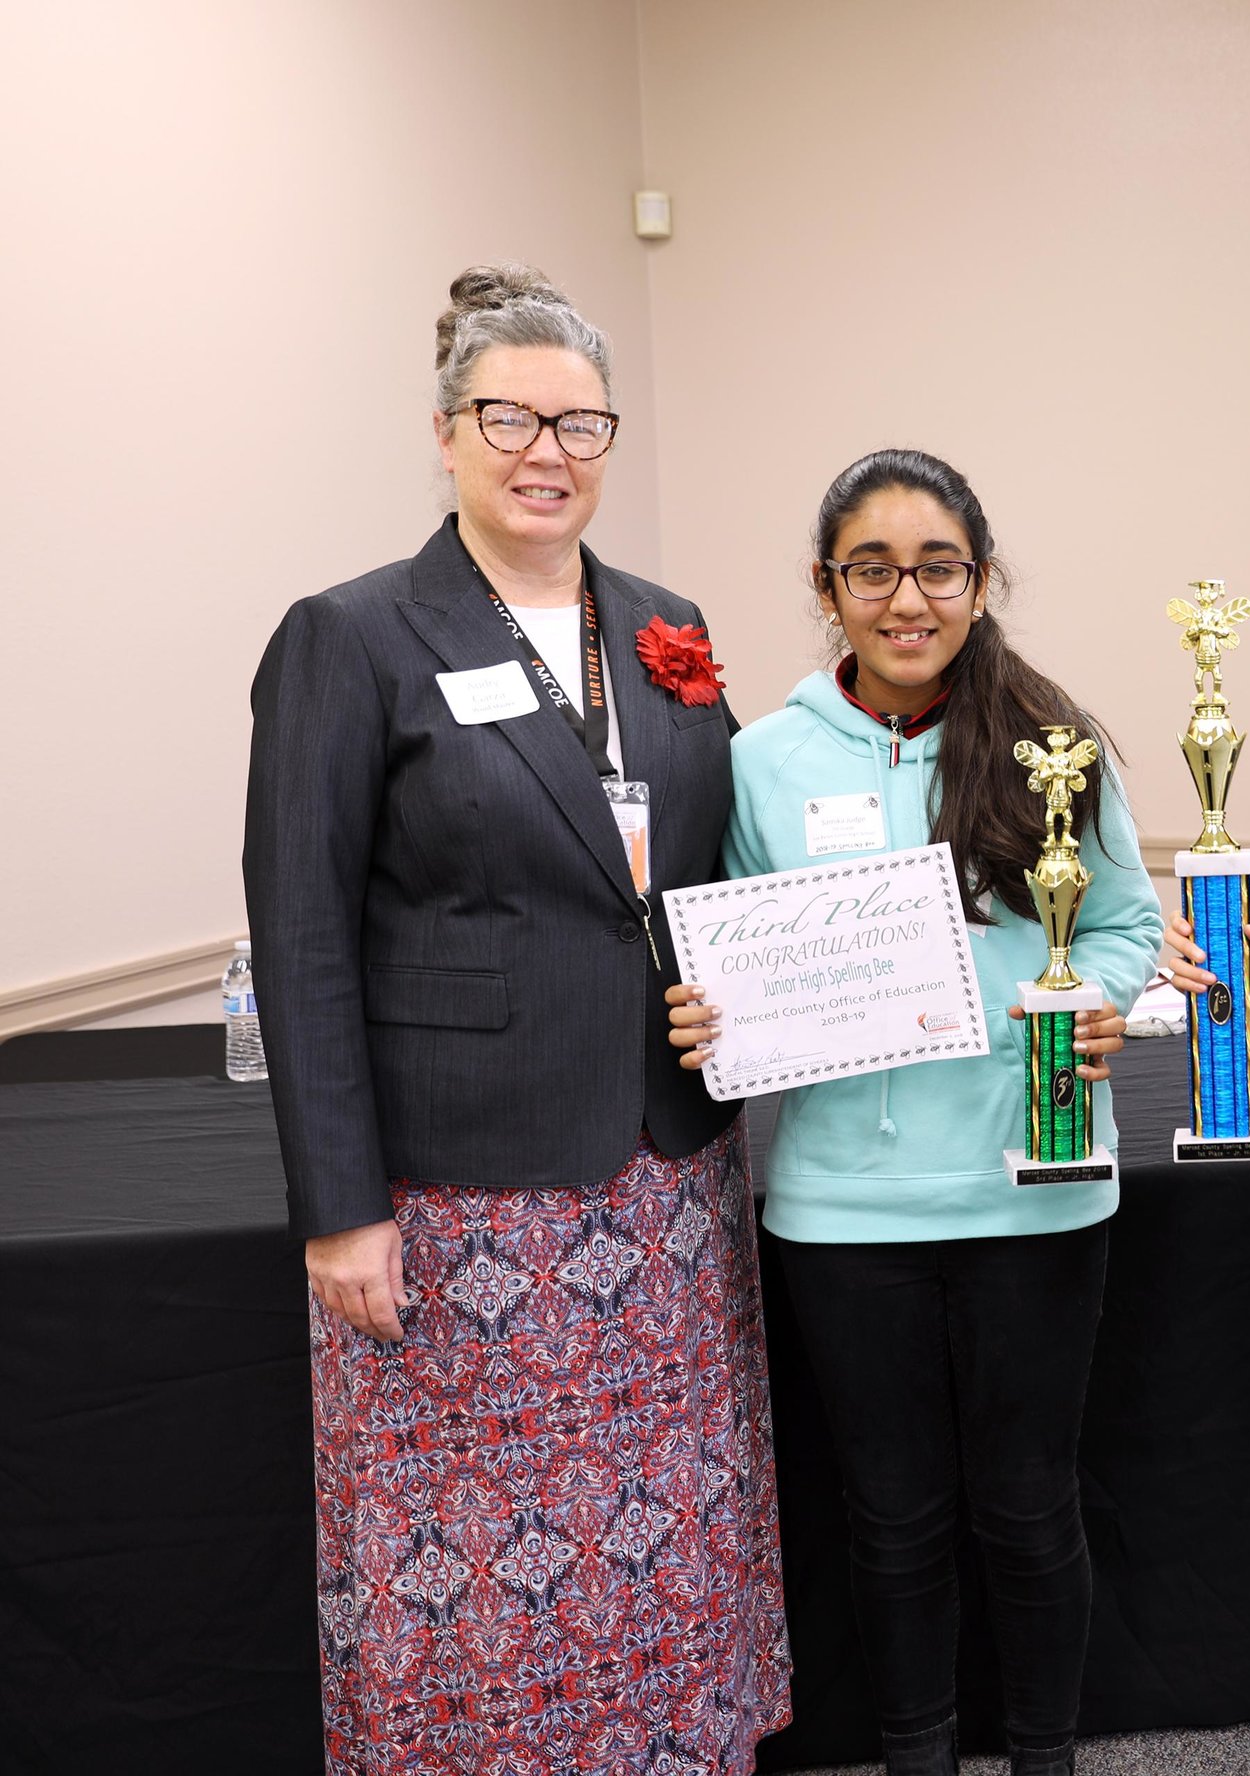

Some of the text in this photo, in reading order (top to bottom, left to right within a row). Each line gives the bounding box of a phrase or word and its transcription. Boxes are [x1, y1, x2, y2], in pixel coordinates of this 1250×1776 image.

[585, 591, 604, 707] NURTURE SERVE
[534, 666, 569, 708] MCOE
[698, 881, 936, 946] Third Place
[721, 920, 925, 976] CONGRATULATIONS!
[763, 957, 895, 998] Junior High Spelling Bee
[734, 980, 946, 1027] Merced County Office of Education
[821, 1010, 866, 1027] 2018-19
[1213, 991, 1228, 1015] 1st
